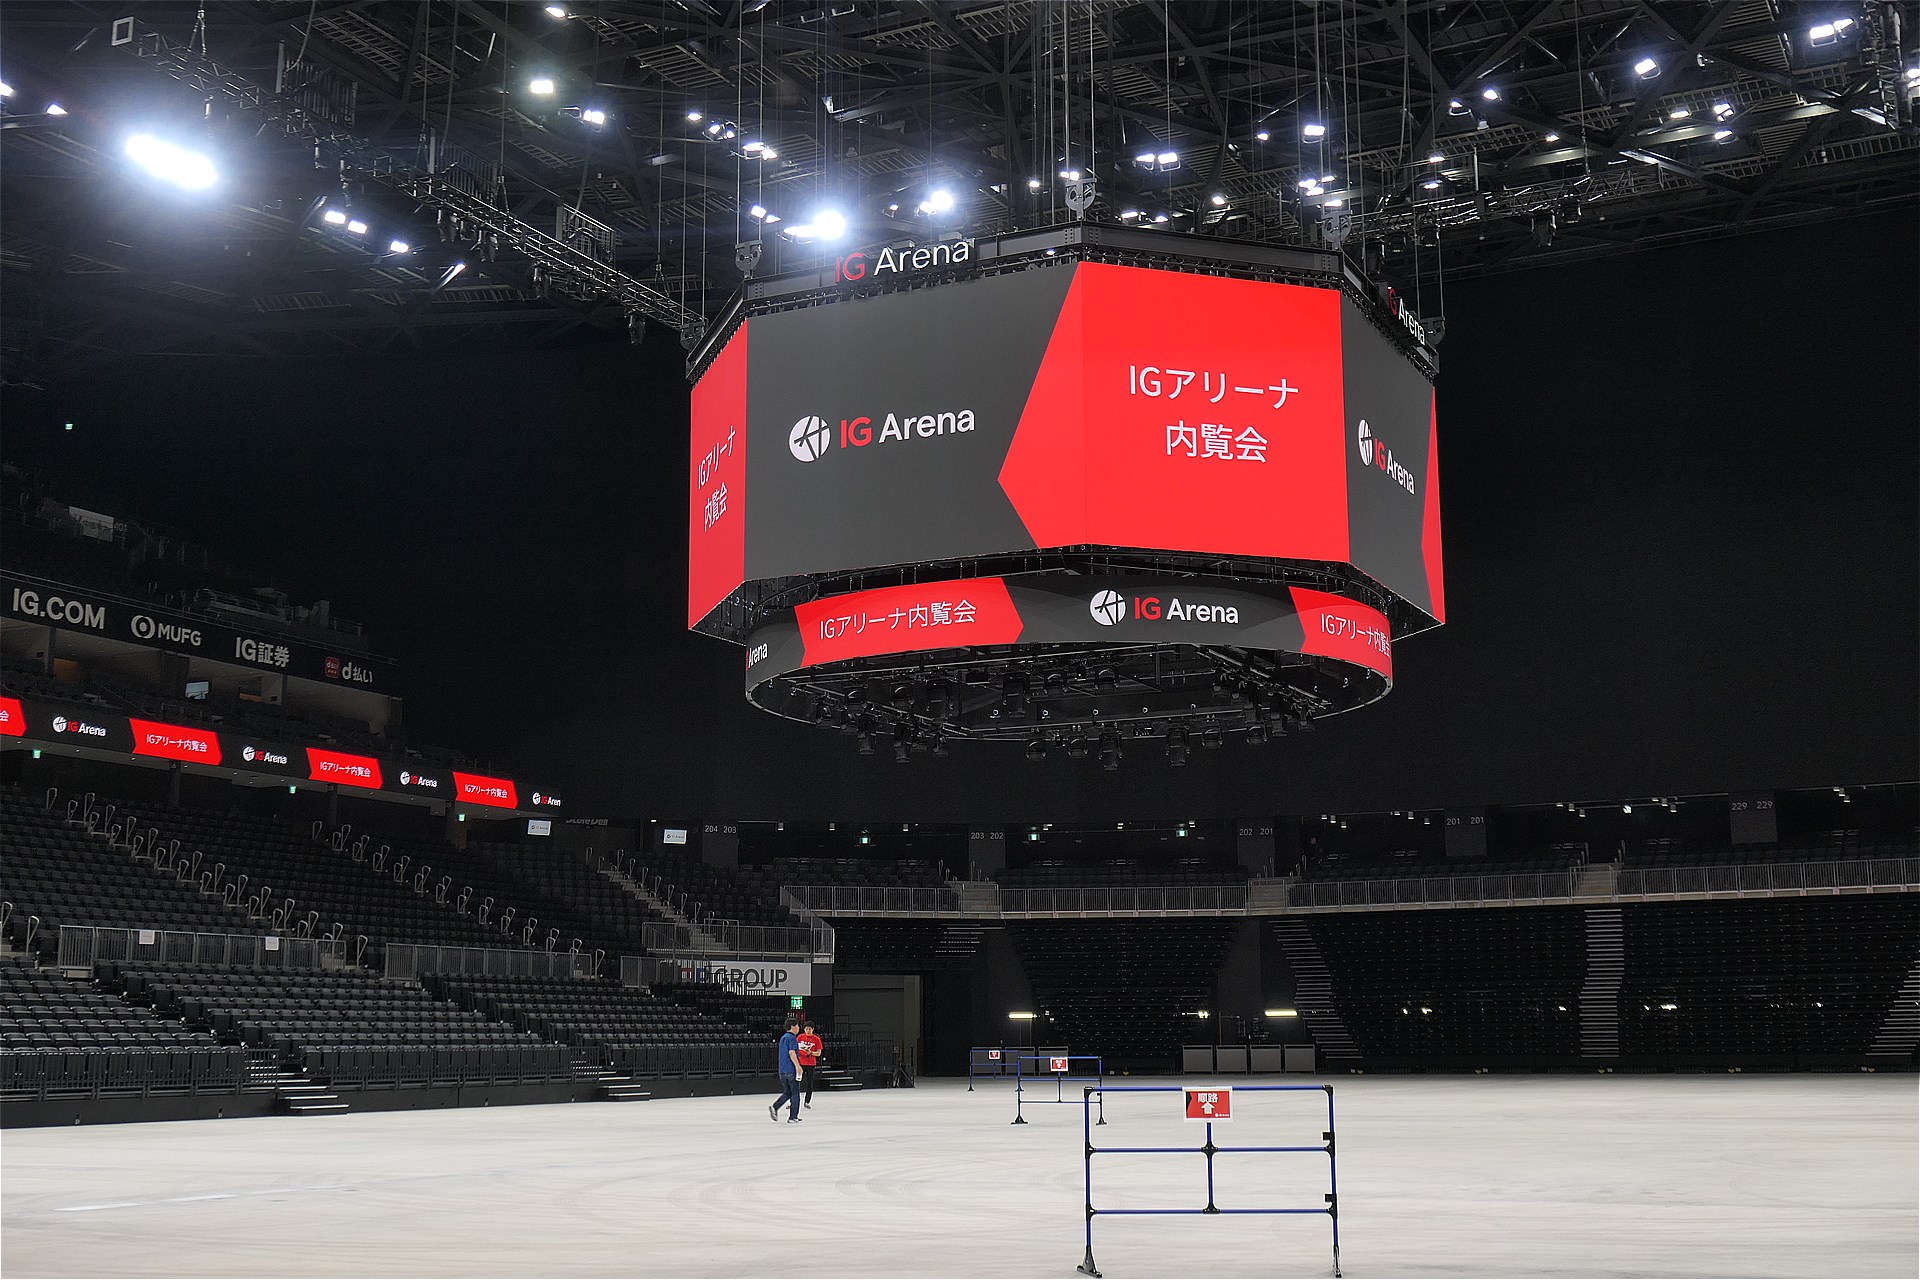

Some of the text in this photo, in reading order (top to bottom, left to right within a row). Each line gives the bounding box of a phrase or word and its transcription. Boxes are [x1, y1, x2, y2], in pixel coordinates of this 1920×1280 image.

[835, 241, 970, 283] IG Arena
[1398, 298, 1425, 346] Arena
[1129, 365, 1299, 410] IGアリーナ
[840, 409, 976, 449] IG Arena
[1166, 420, 1269, 463] 内覧会
[698, 425, 736, 490] IGアリーナ
[1374, 437, 1415, 494] IG Arena
[704, 481, 728, 532] 内覧会
[13, 588, 105, 630] IG.COM
[819, 599, 977, 640] IGアリーナ内覧会
[1134, 597, 1239, 623] IG Arena
[157, 622, 202, 647] MUFG
[235, 637, 290, 668] IG証券
[748, 642, 768, 669] Arena
[342, 662, 373, 683] d払い
[67, 720, 107, 737] IG Arena
[146, 734, 208, 752] IGアリーナ内覧会
[255, 750, 288, 764] IG Arena
[320, 761, 371, 778] IGアリーナ内覧会
[418, 776, 437, 788] Arena
[1731, 801, 1773, 811] 229 229
[704, 825, 737, 834] 204 203
[1446, 816, 1485, 826] 201 201
[970, 832, 985, 840] 203
